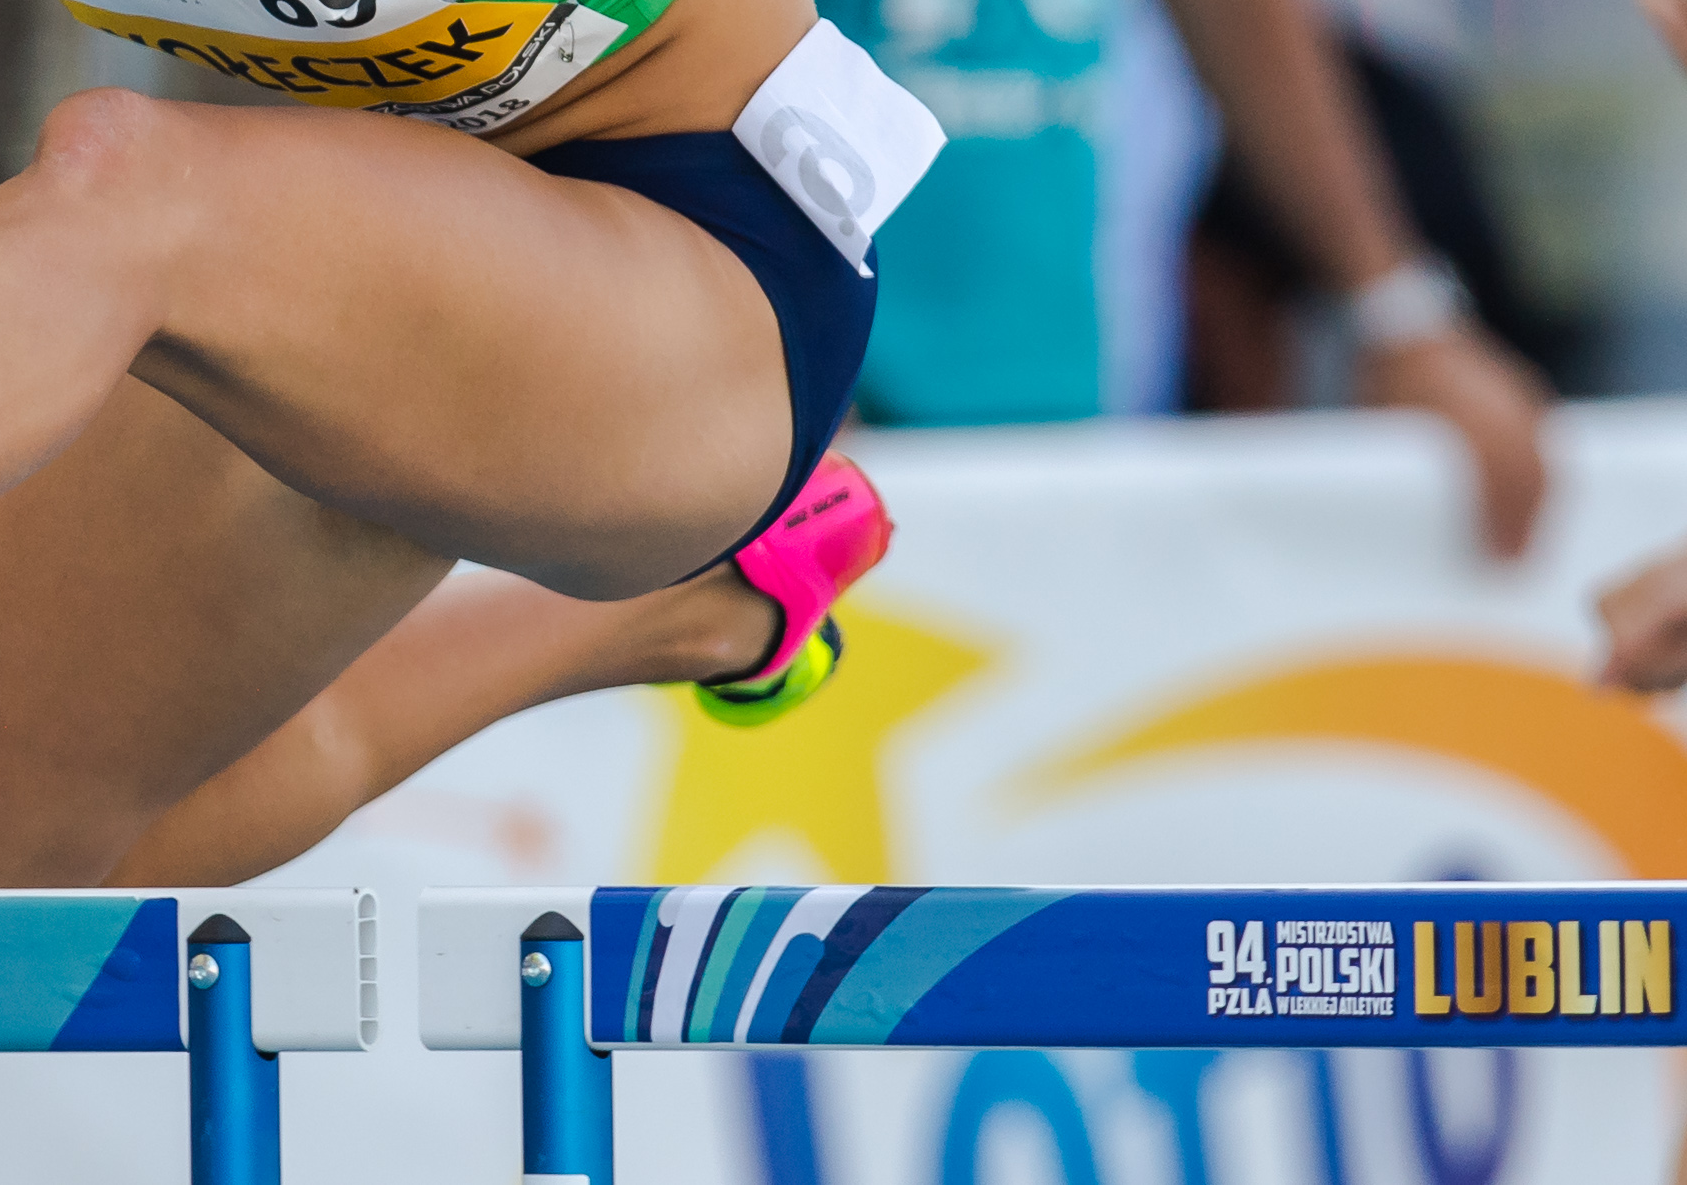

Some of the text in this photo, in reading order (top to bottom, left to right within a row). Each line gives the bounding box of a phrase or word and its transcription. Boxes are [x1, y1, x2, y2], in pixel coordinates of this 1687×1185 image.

[100, 18, 514, 93] OŁECZEK
[480, 22, 556, 96] POLSKI
[1207, 920, 1273, 984] 94.
[1276, 920, 1395, 944] MISTRZOSTWA
[1276, 947, 1396, 994] POLSKI
[1413, 919, 1671, 1015] LUBLIN
[1208, 987, 1274, 1015] PZLA
[1276, 996, 1395, 1015] W LEKKIEJ ATLETYCE
